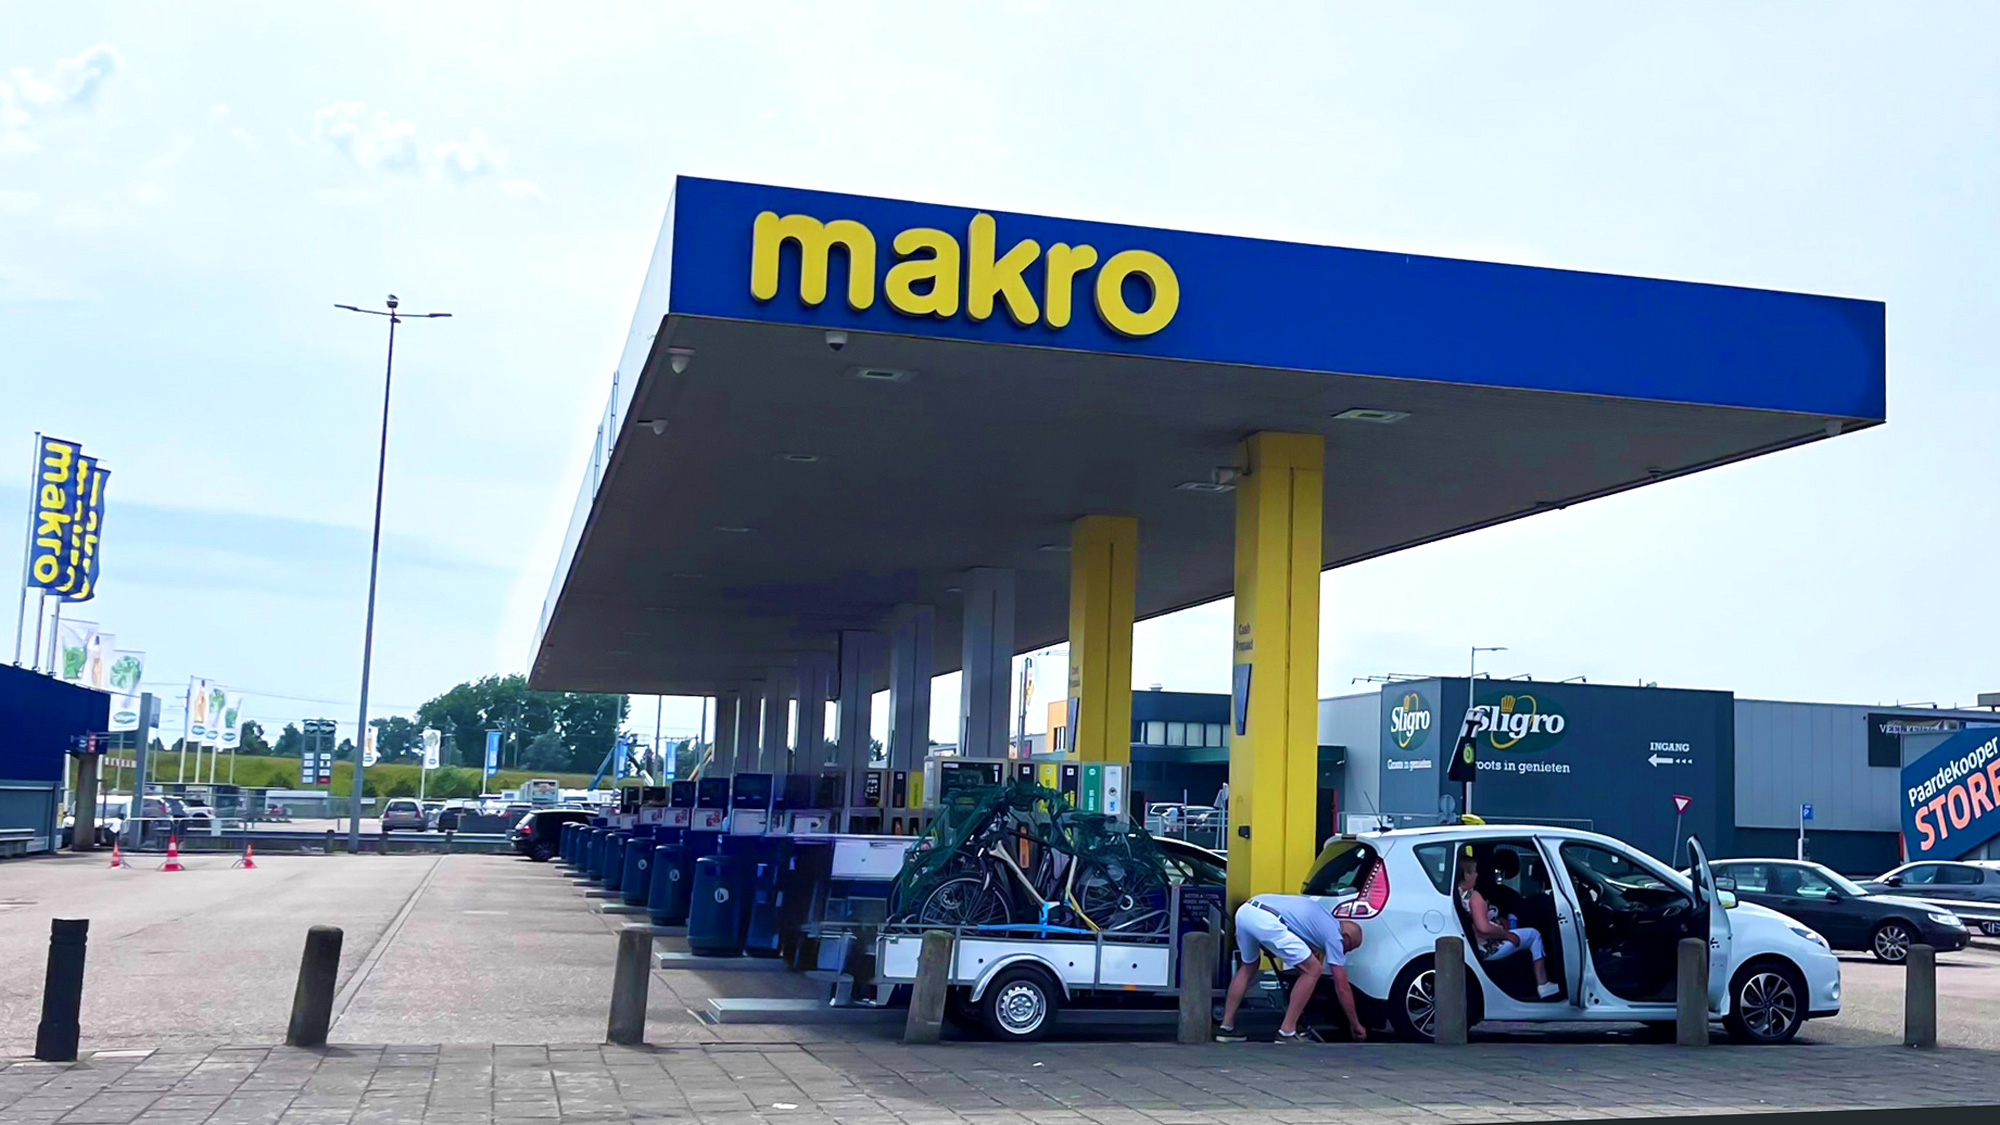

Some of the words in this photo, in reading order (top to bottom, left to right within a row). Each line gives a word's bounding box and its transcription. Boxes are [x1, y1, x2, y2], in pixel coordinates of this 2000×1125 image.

[751, 211, 1180, 336] makro
[34, 442, 72, 583] makro
[1391, 706, 1430, 737] Sligro
[1650, 742, 1690, 752] INGANG
[1504, 760, 1516, 771] in
[1519, 762, 1570, 774] genieten
[1908, 736, 1998, 807] Paardekooper
